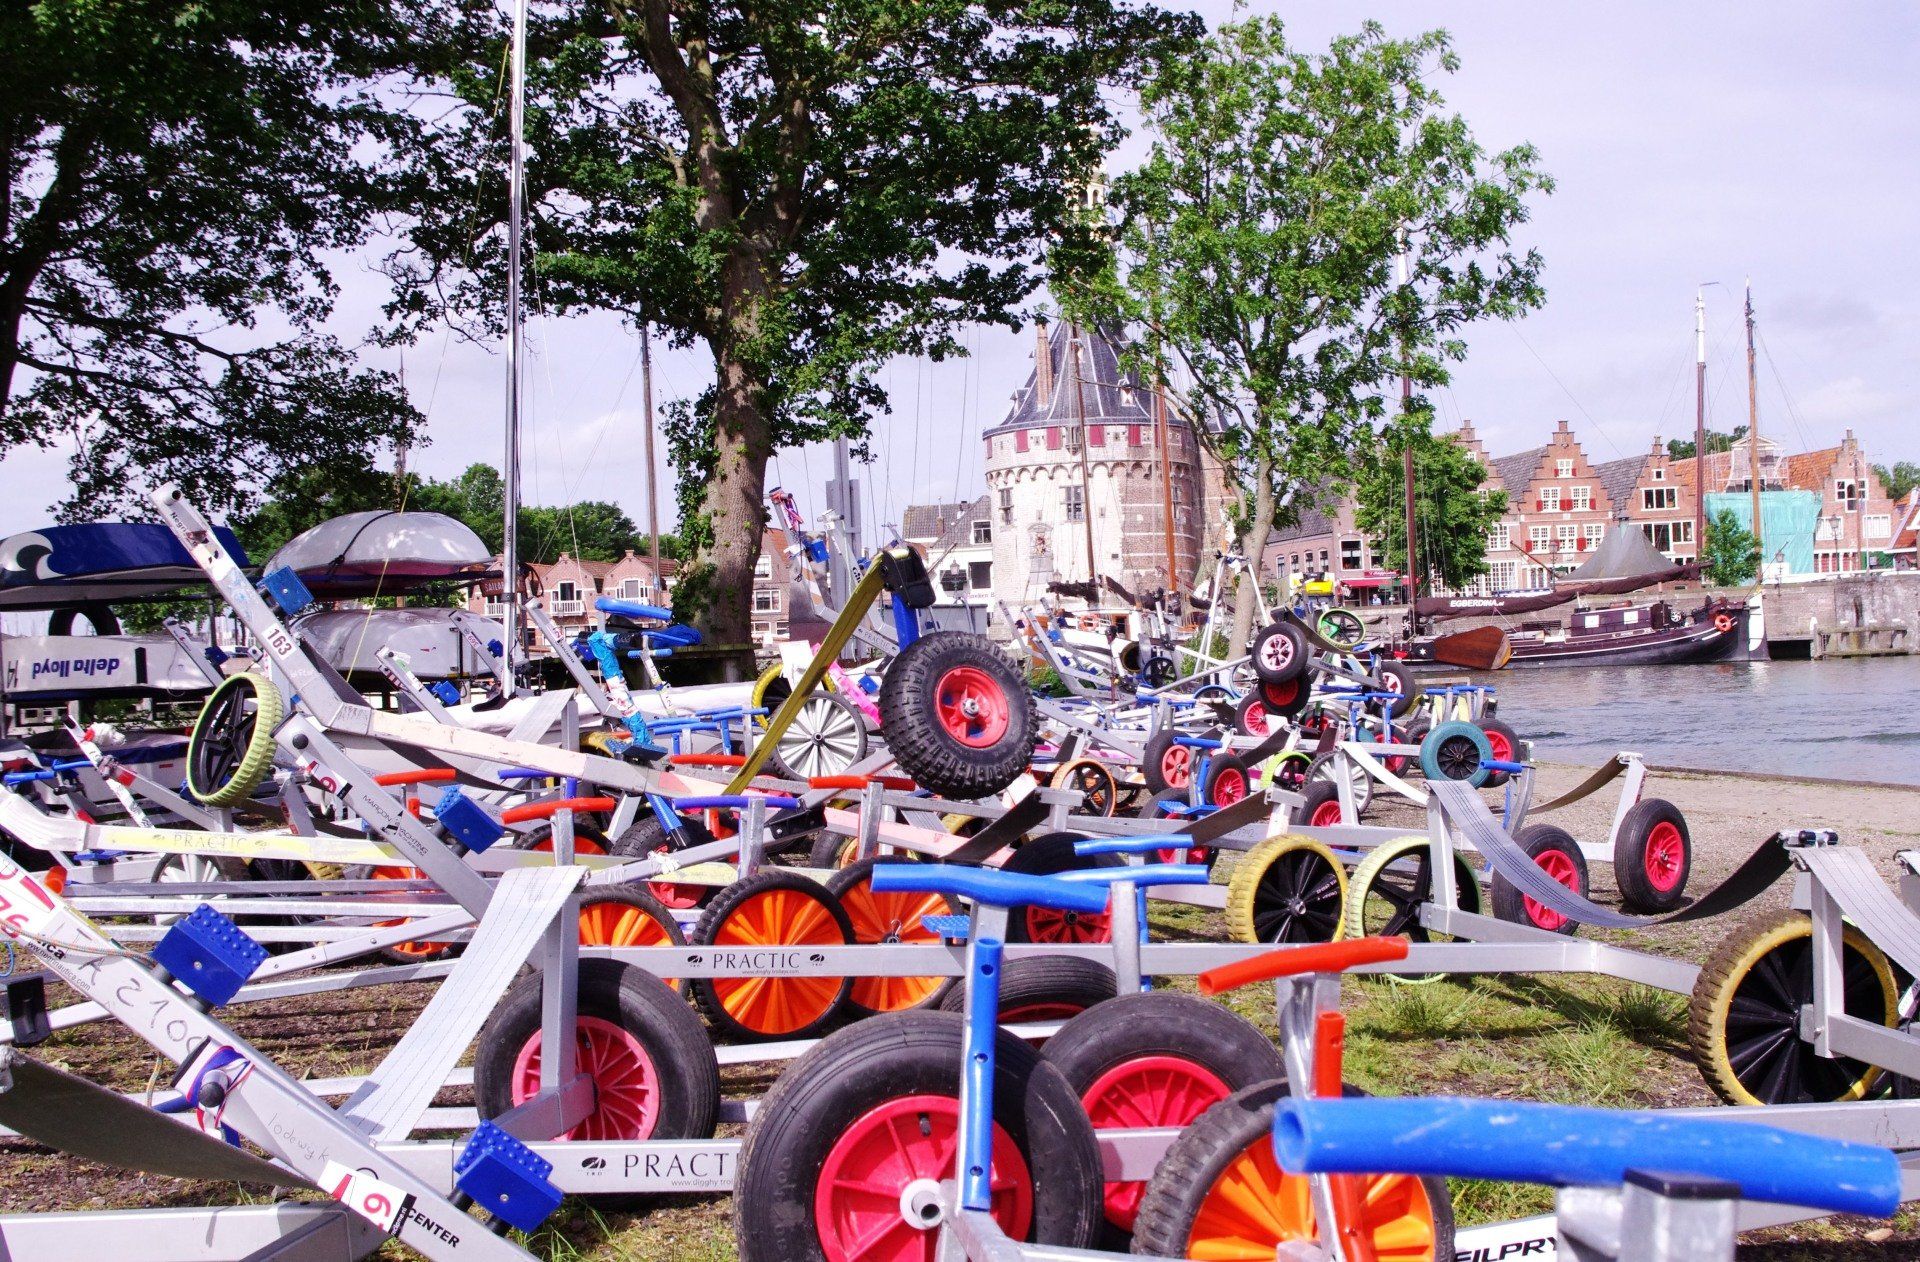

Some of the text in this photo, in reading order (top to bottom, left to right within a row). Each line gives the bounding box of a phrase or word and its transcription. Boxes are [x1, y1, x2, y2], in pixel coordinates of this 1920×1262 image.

[267, 628, 293, 656] 163
[32, 658, 120, 680] delta lloyd
[174, 834, 247, 849] PRACTIC
[400, 828, 429, 855] YACHTING
[713, 952, 801, 969] PRACTIC
[406, 1208, 461, 1248] CENTER
